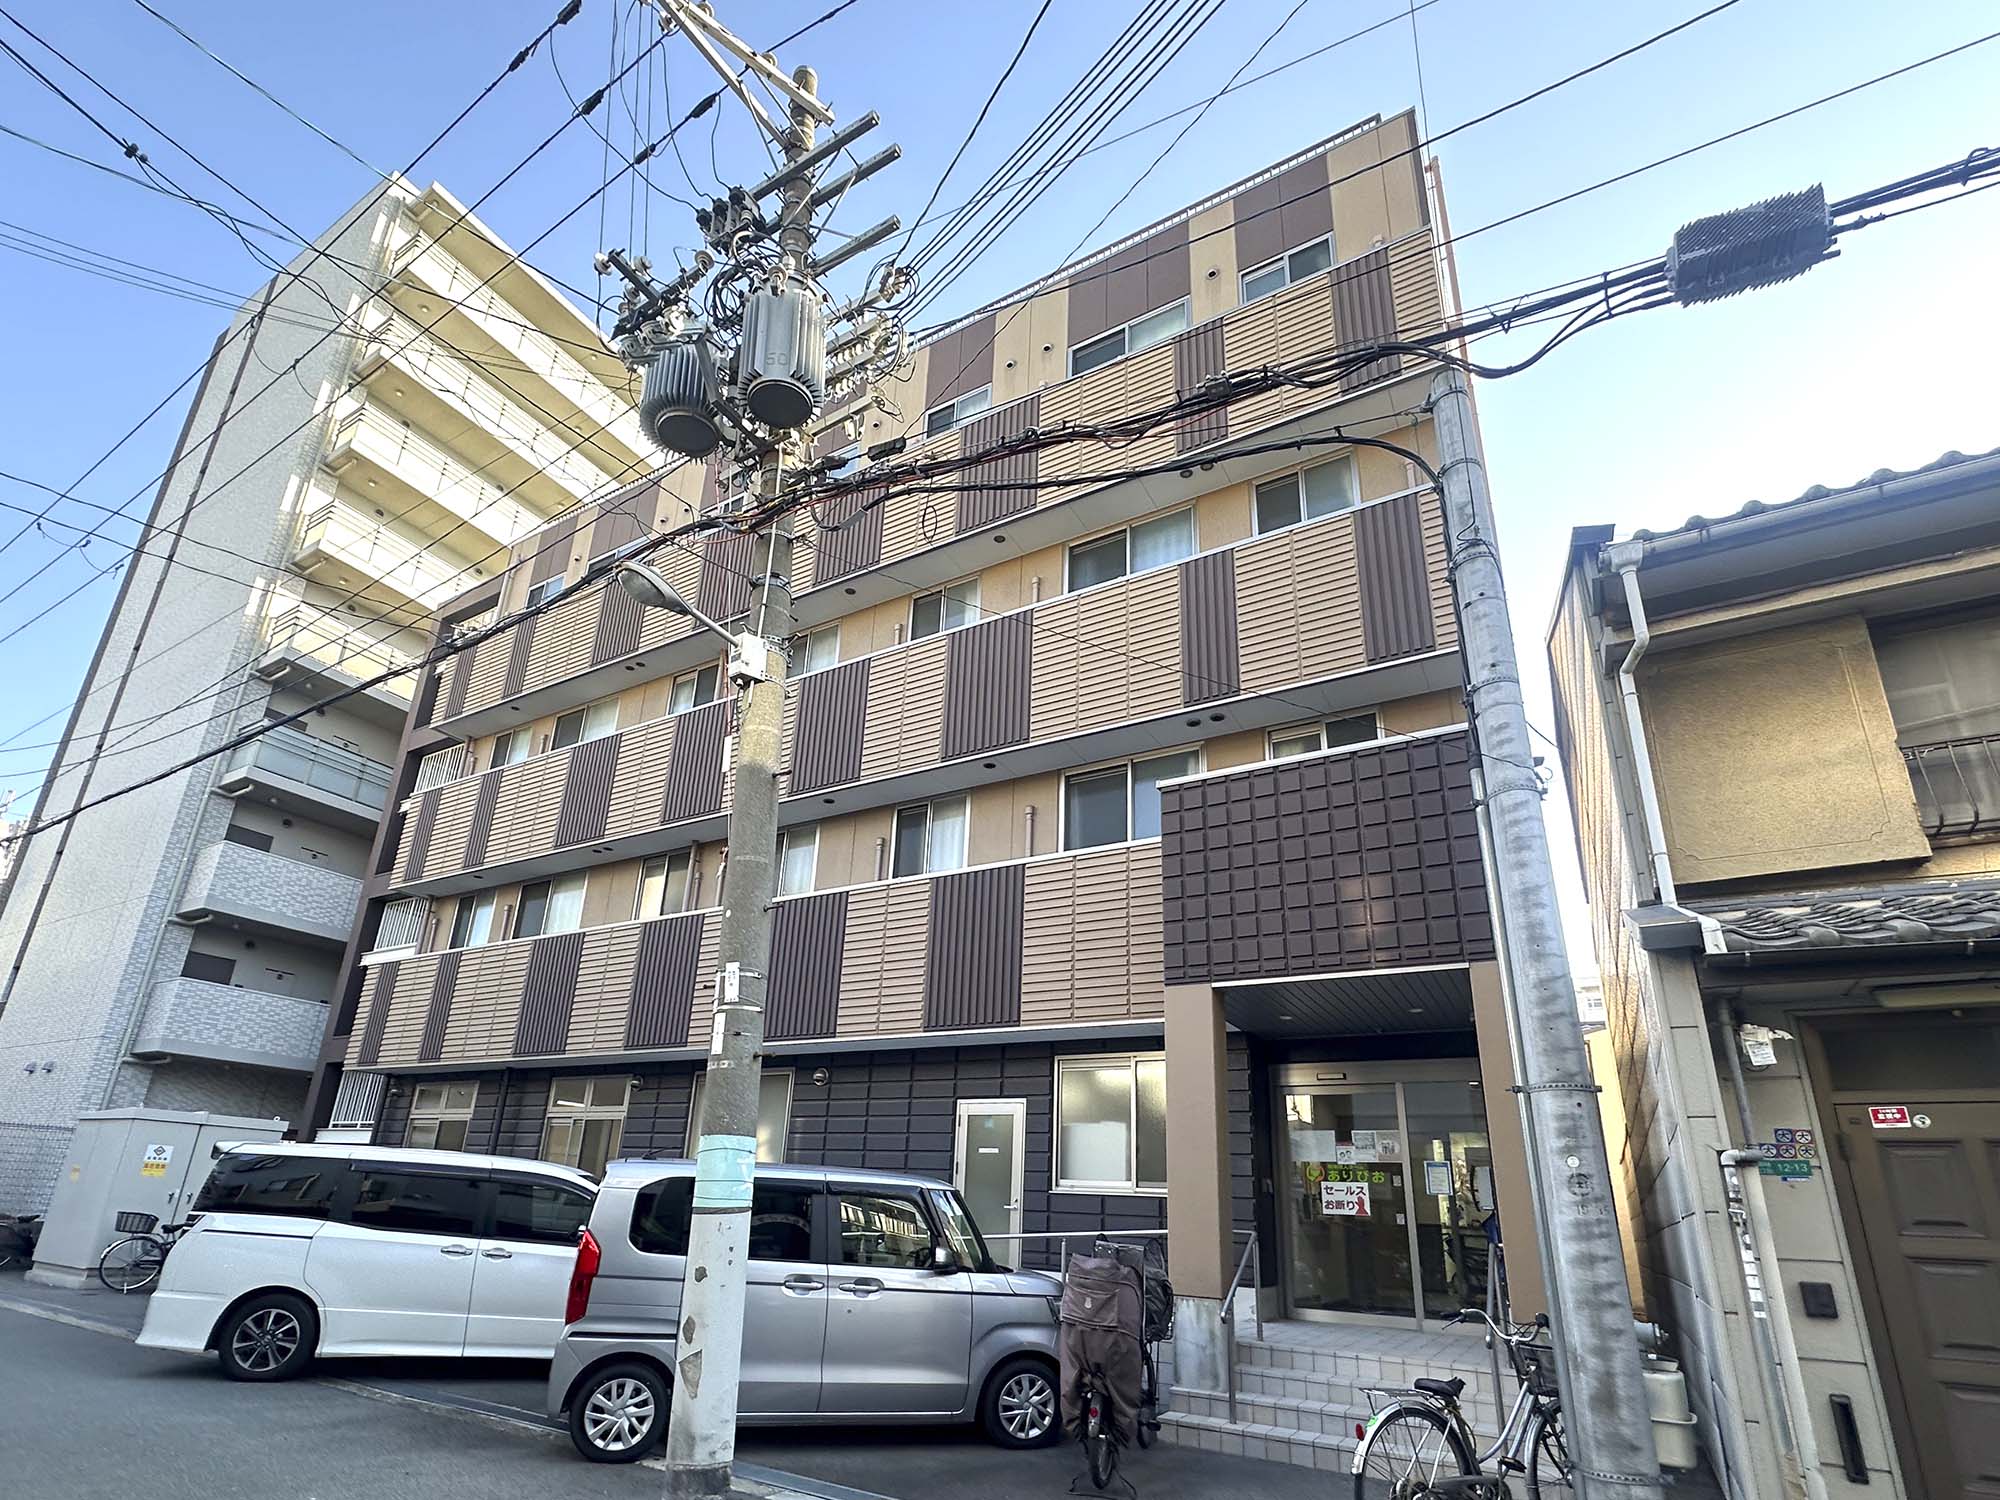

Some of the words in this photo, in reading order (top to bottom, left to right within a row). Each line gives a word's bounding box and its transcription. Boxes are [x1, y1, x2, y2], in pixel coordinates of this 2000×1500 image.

[1777, 1162, 1808, 1173] 12-13
[1327, 1169, 1385, 1183] ありびお
[1324, 1185, 1366, 1196] セールス
[1324, 1199, 1355, 1210] お断り
